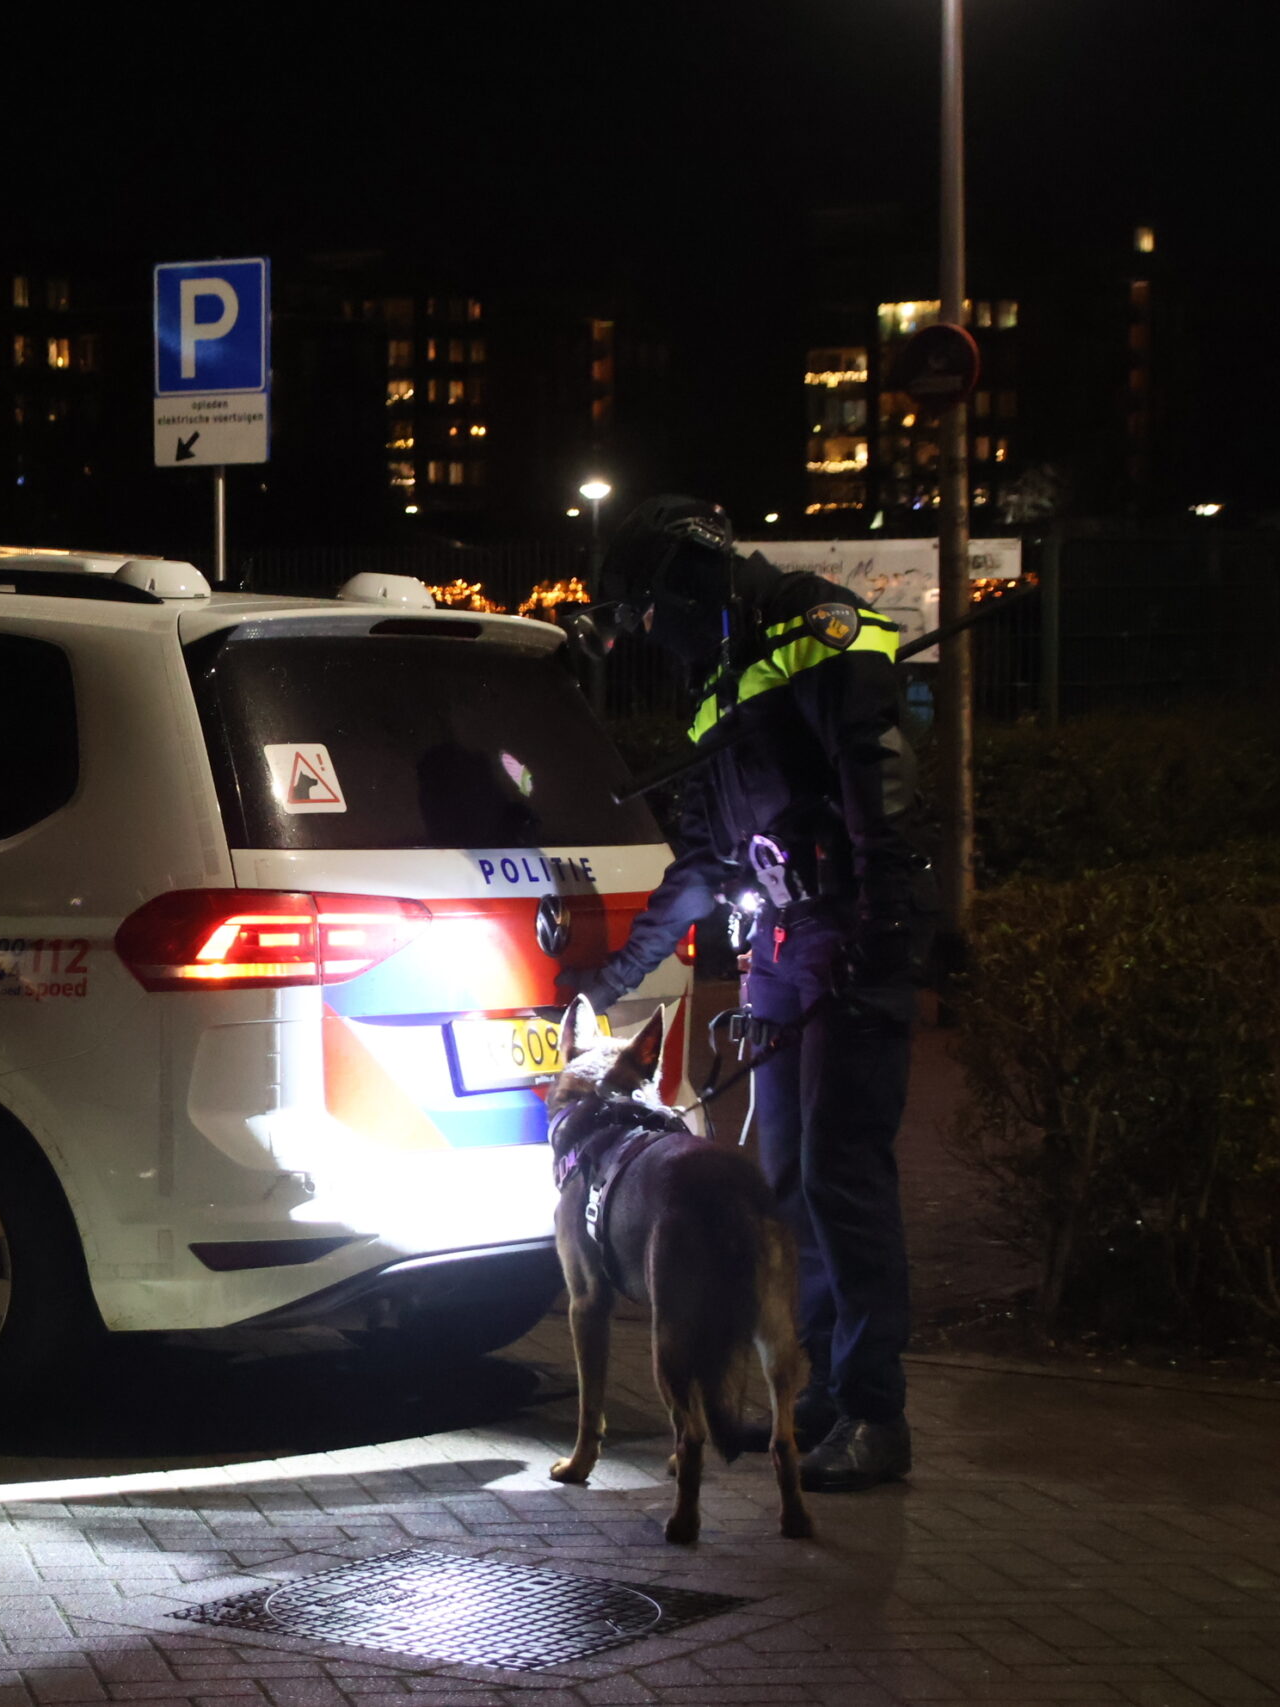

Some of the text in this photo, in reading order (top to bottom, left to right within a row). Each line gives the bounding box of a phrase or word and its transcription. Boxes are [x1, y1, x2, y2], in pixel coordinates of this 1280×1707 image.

[180, 277, 239, 379] P
[191, 399, 228, 411] opladen
[157, 411, 264, 426] elektrische voertuigen
[479, 857, 596, 884] POLITIE
[31, 938, 90, 973] 112
[25, 977, 87, 1000] spoed
